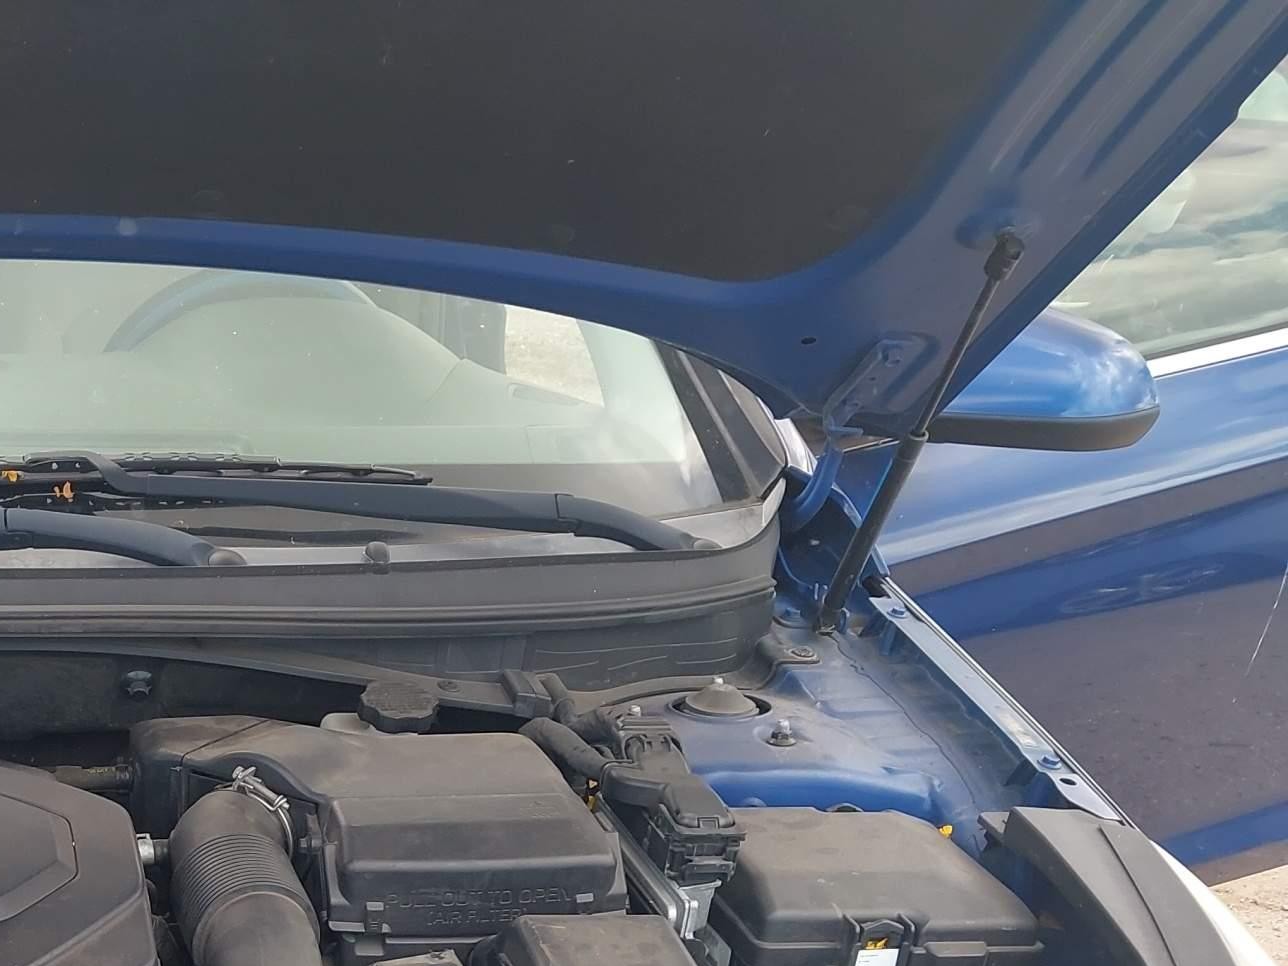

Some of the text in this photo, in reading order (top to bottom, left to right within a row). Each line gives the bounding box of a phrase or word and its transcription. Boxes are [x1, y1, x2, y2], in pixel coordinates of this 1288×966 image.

[385, 886, 573, 908] PULL OUT TO OPEN
